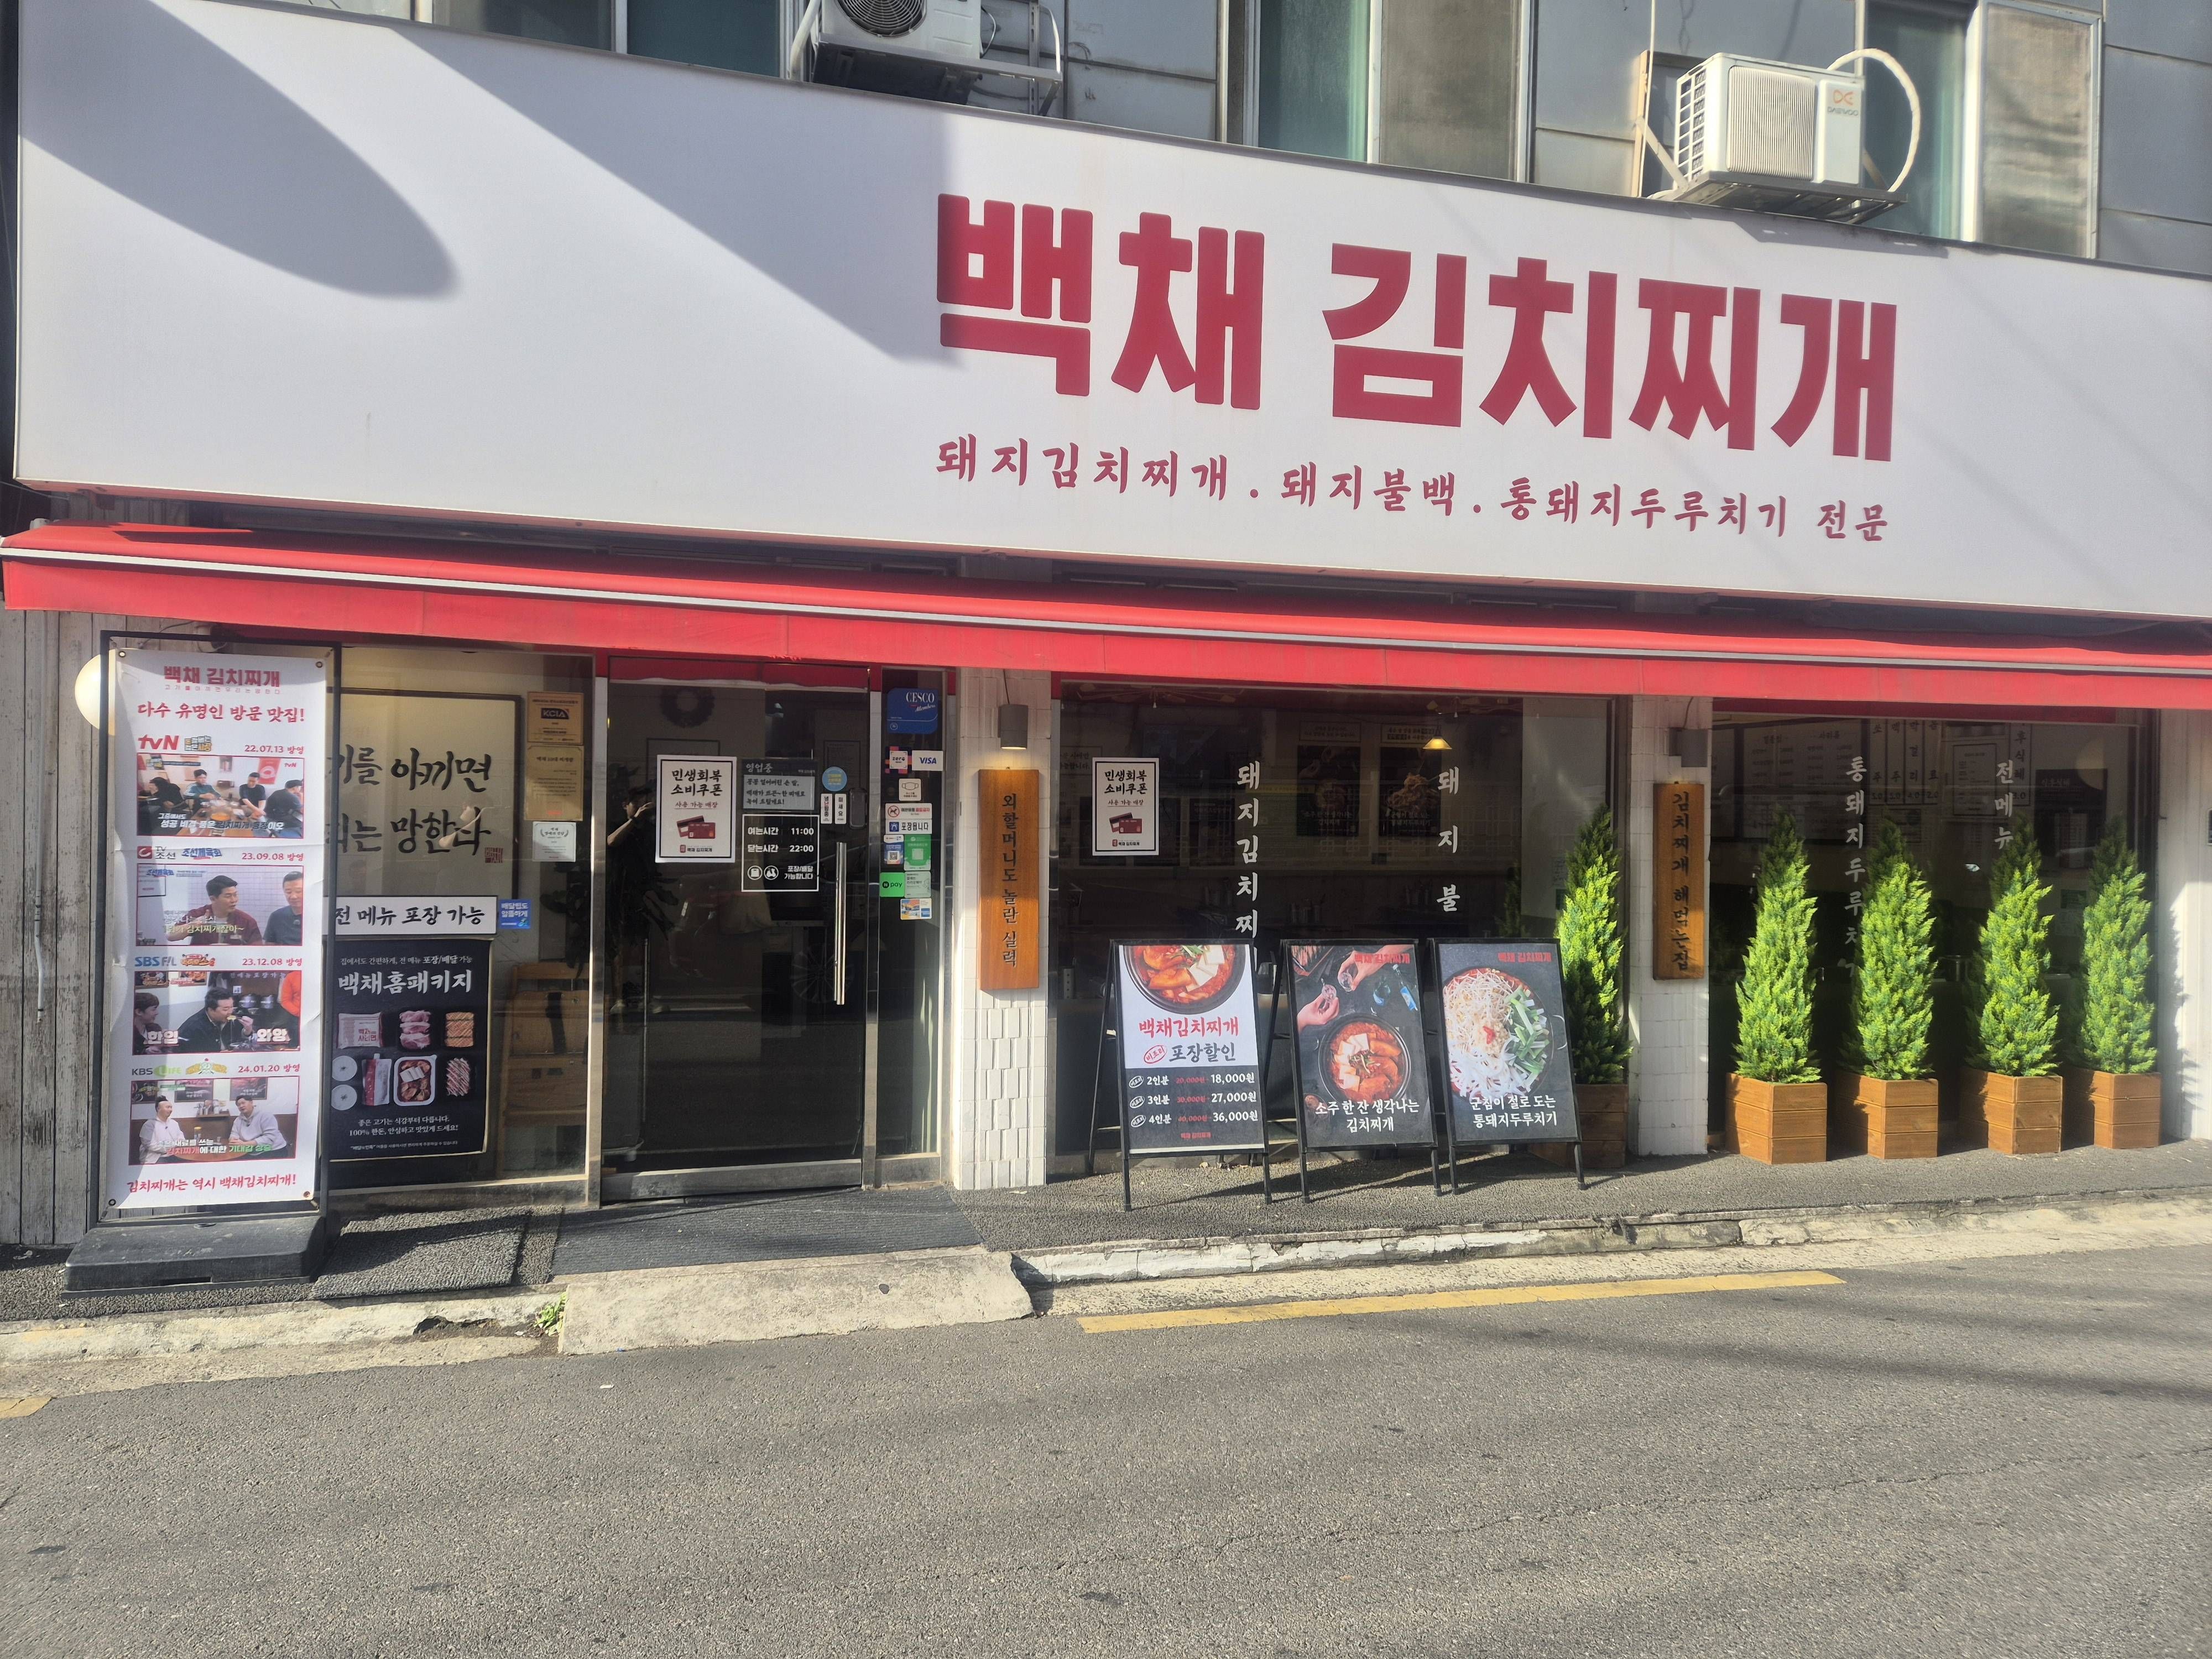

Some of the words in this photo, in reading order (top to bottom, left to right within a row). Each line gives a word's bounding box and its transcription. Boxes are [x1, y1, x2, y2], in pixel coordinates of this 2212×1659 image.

[1827, 107, 1859, 116] DAEWOO
[937, 194, 1265, 410] 백채
[1322, 243, 1897, 461] 김치찌개
[1500, 477, 1786, 538] 통돼지두루치기
[1817, 499, 1888, 542] 전문
[164, 666, 200, 684] 백채
[207, 668, 280, 687] 김치찌개
[906, 692, 935, 703] CESCO
[138, 701, 171, 718] 다수
[175, 703, 224, 719] 유명인
[230, 705, 263, 721] 방문
[267, 706, 304, 723] 맛집!
[138, 734, 179, 750] tvN
[244, 745, 284, 753] 22.07.13
[287, 747, 304, 755] 방영
[391, 748, 491, 792] 아끼면
[671, 768, 723, 782] 민생회복
[746, 763, 773, 774] 영업중
[1104, 769, 1147, 782] 민생회복
[670, 783, 723, 797] 소비쿠폰
[1104, 782, 1148, 795] 소비쿠폰
[160, 820, 178, 828] 성공
[901, 822, 928, 831] 포장됩니다
[390, 807, 491, 856] 망한다
[748, 827, 779, 836] 여는시간
[791, 827, 814, 836] 11:00
[1001, 794, 1018, 881] 외할머니도
[1672, 791, 1689, 877] 김치찌개
[748, 844, 779, 853] 닫는시간
[789, 844, 814, 853] 22:00
[155, 852, 176, 860] 조선
[287, 853, 304, 862] 방영
[1001, 889, 1019, 924] 놀란
[335, 905, 350, 926] 전
[357, 905, 397, 926] 메뉴
[401, 905, 441, 926] 포장
[446, 905, 485, 925] 가능
[1002, 931, 1016, 968] 실력
[135, 957, 160, 967] SBS
[286, 958, 302, 967] 방영
[422, 955, 457, 964] 포장/배달
[1375, 952, 1410, 964] 김치찌개
[1518, 952, 1552, 963] 김치찌개
[338, 969, 472, 995] 백채홈패키지
[1139, 1016, 1239, 1039] 백채김치찌개
[1168, 1042, 1236, 1063] 포장할인
[238, 1065, 279, 1073] 24.01.20
[283, 1064, 300, 1073] 방영
[1146, 1075, 1170, 1086] 2인분
[1211, 1072, 1255, 1085] 18,000원
[1147, 1094, 1171, 1105] 3인분
[1212, 1091, 1257, 1104] 27,000원
[1470, 1096, 1505, 1112] 군침이
[1507, 1096, 1530, 1110] 절로
[1533, 1095, 1557, 1109] 도는
[1315, 1102, 1340, 1116] 소주
[1342, 1101, 1354, 1115] 한
[1357, 1100, 1370, 1114] 잔
[1372, 1099, 1420, 1114] 생각나는
[1149, 1114, 1172, 1125] 4인분
[1213, 1110, 1258, 1123] 36,000원
[1473, 1111, 1558, 1129] 통돼지두루치기
[388, 1126, 414, 1135] 안심하고
[416, 1125, 435, 1133] 맛있게
[1347, 1117, 1394, 1133] 김치찌개
[210, 1145, 226, 1154] 대한
[127, 1177, 188, 1193] 김치찌개는
[192, 1176, 215, 1191] 역시
[220, 1173, 296, 1189] 백채김치찌개!
